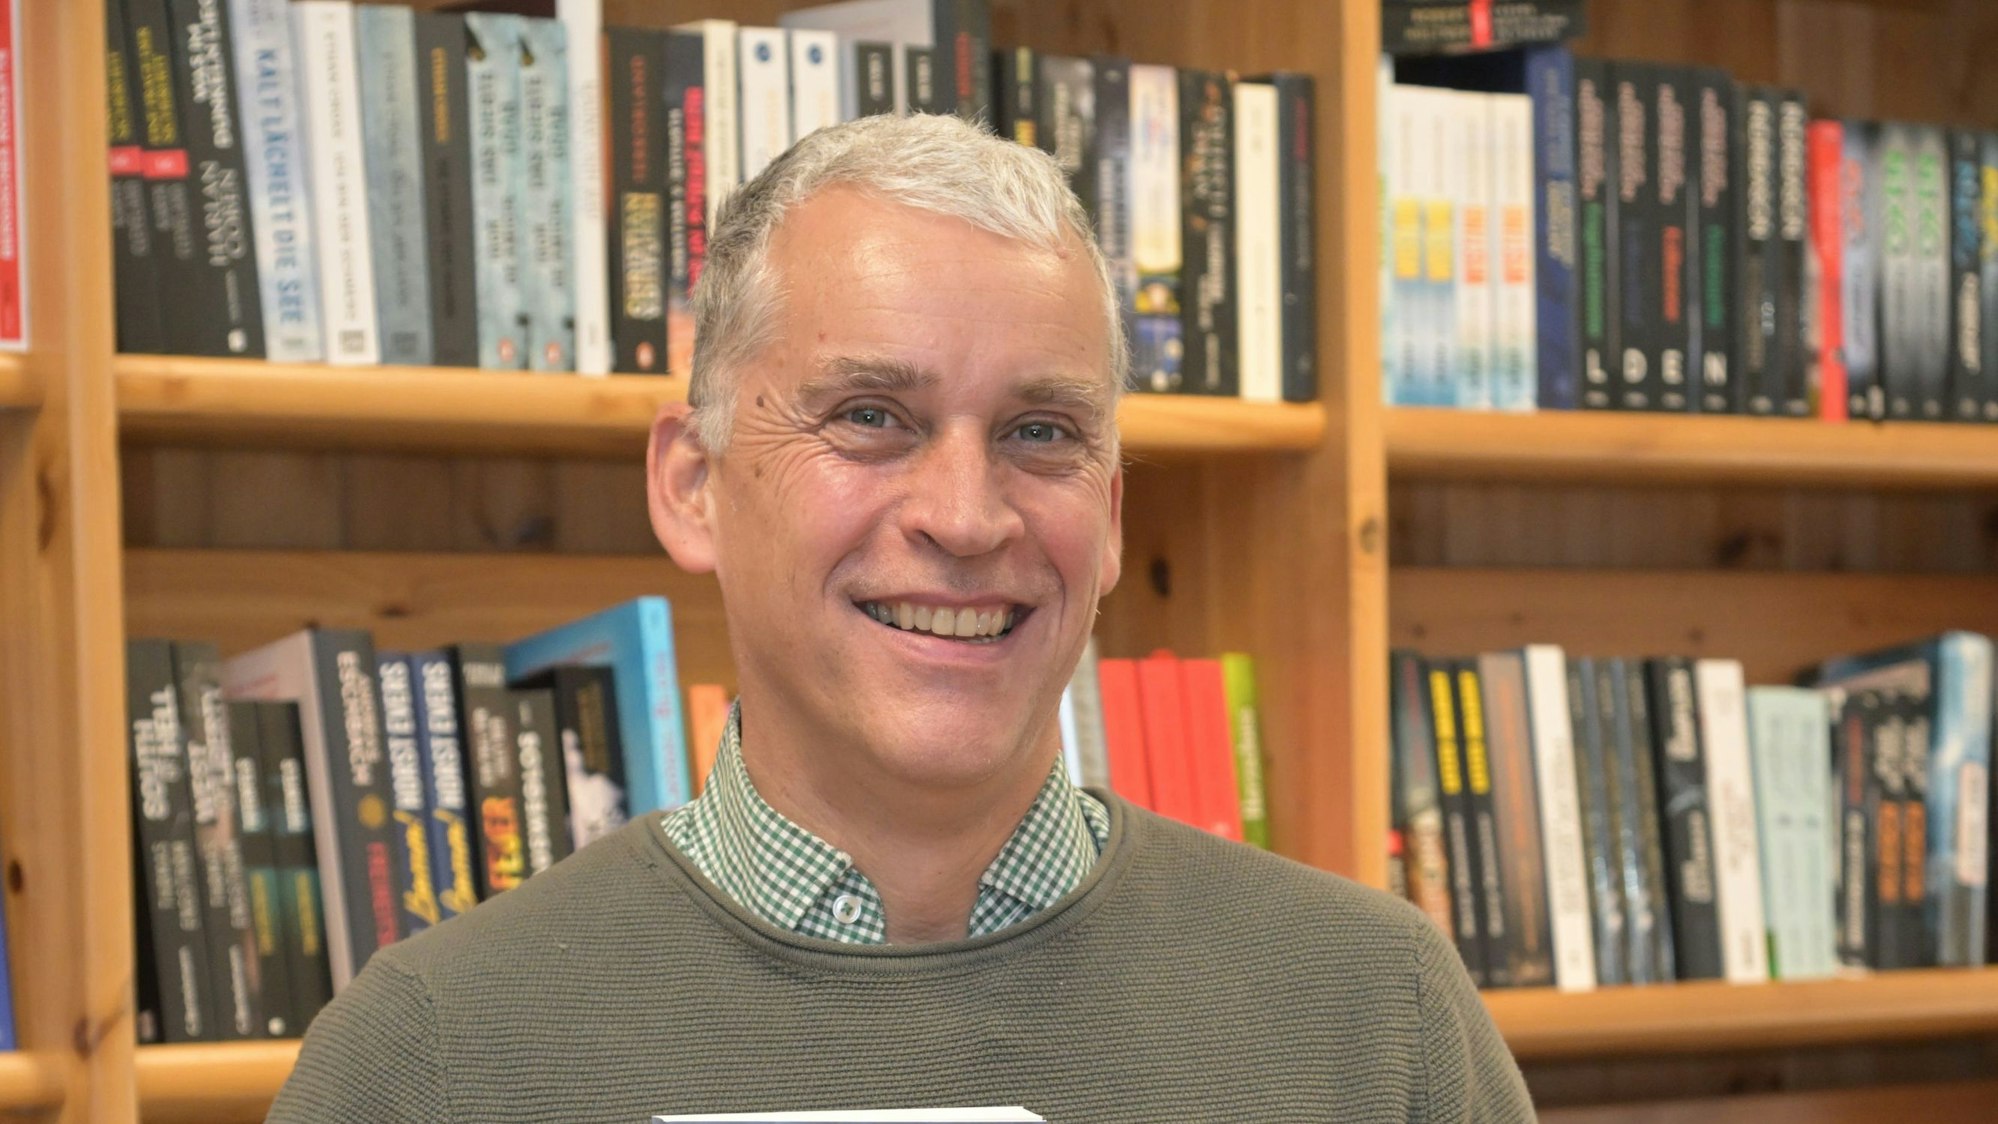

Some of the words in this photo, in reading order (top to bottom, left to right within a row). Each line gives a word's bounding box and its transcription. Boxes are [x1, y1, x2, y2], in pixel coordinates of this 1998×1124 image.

[257, 49, 281, 106] KALT
[261, 115, 292, 223] LÄCHELT
[274, 228, 298, 271] DIE
[278, 277, 305, 324] SEE
[1587, 349, 1608, 384] L
[1622, 347, 1647, 384] D
[1661, 349, 1684, 384] E
[1703, 350, 1727, 386] N
[149, 684, 182, 757] HELL
[336, 650, 374, 787] ESCHBACH
[379, 660, 416, 735] EVERS
[421, 660, 459, 734] EVERS
[133, 717, 171, 822] SOUTH
[187, 740, 217, 824] WEST
[387, 736, 425, 811] HORST
[429, 735, 466, 810] HORST
[517, 730, 555, 872] USWEGLOS
